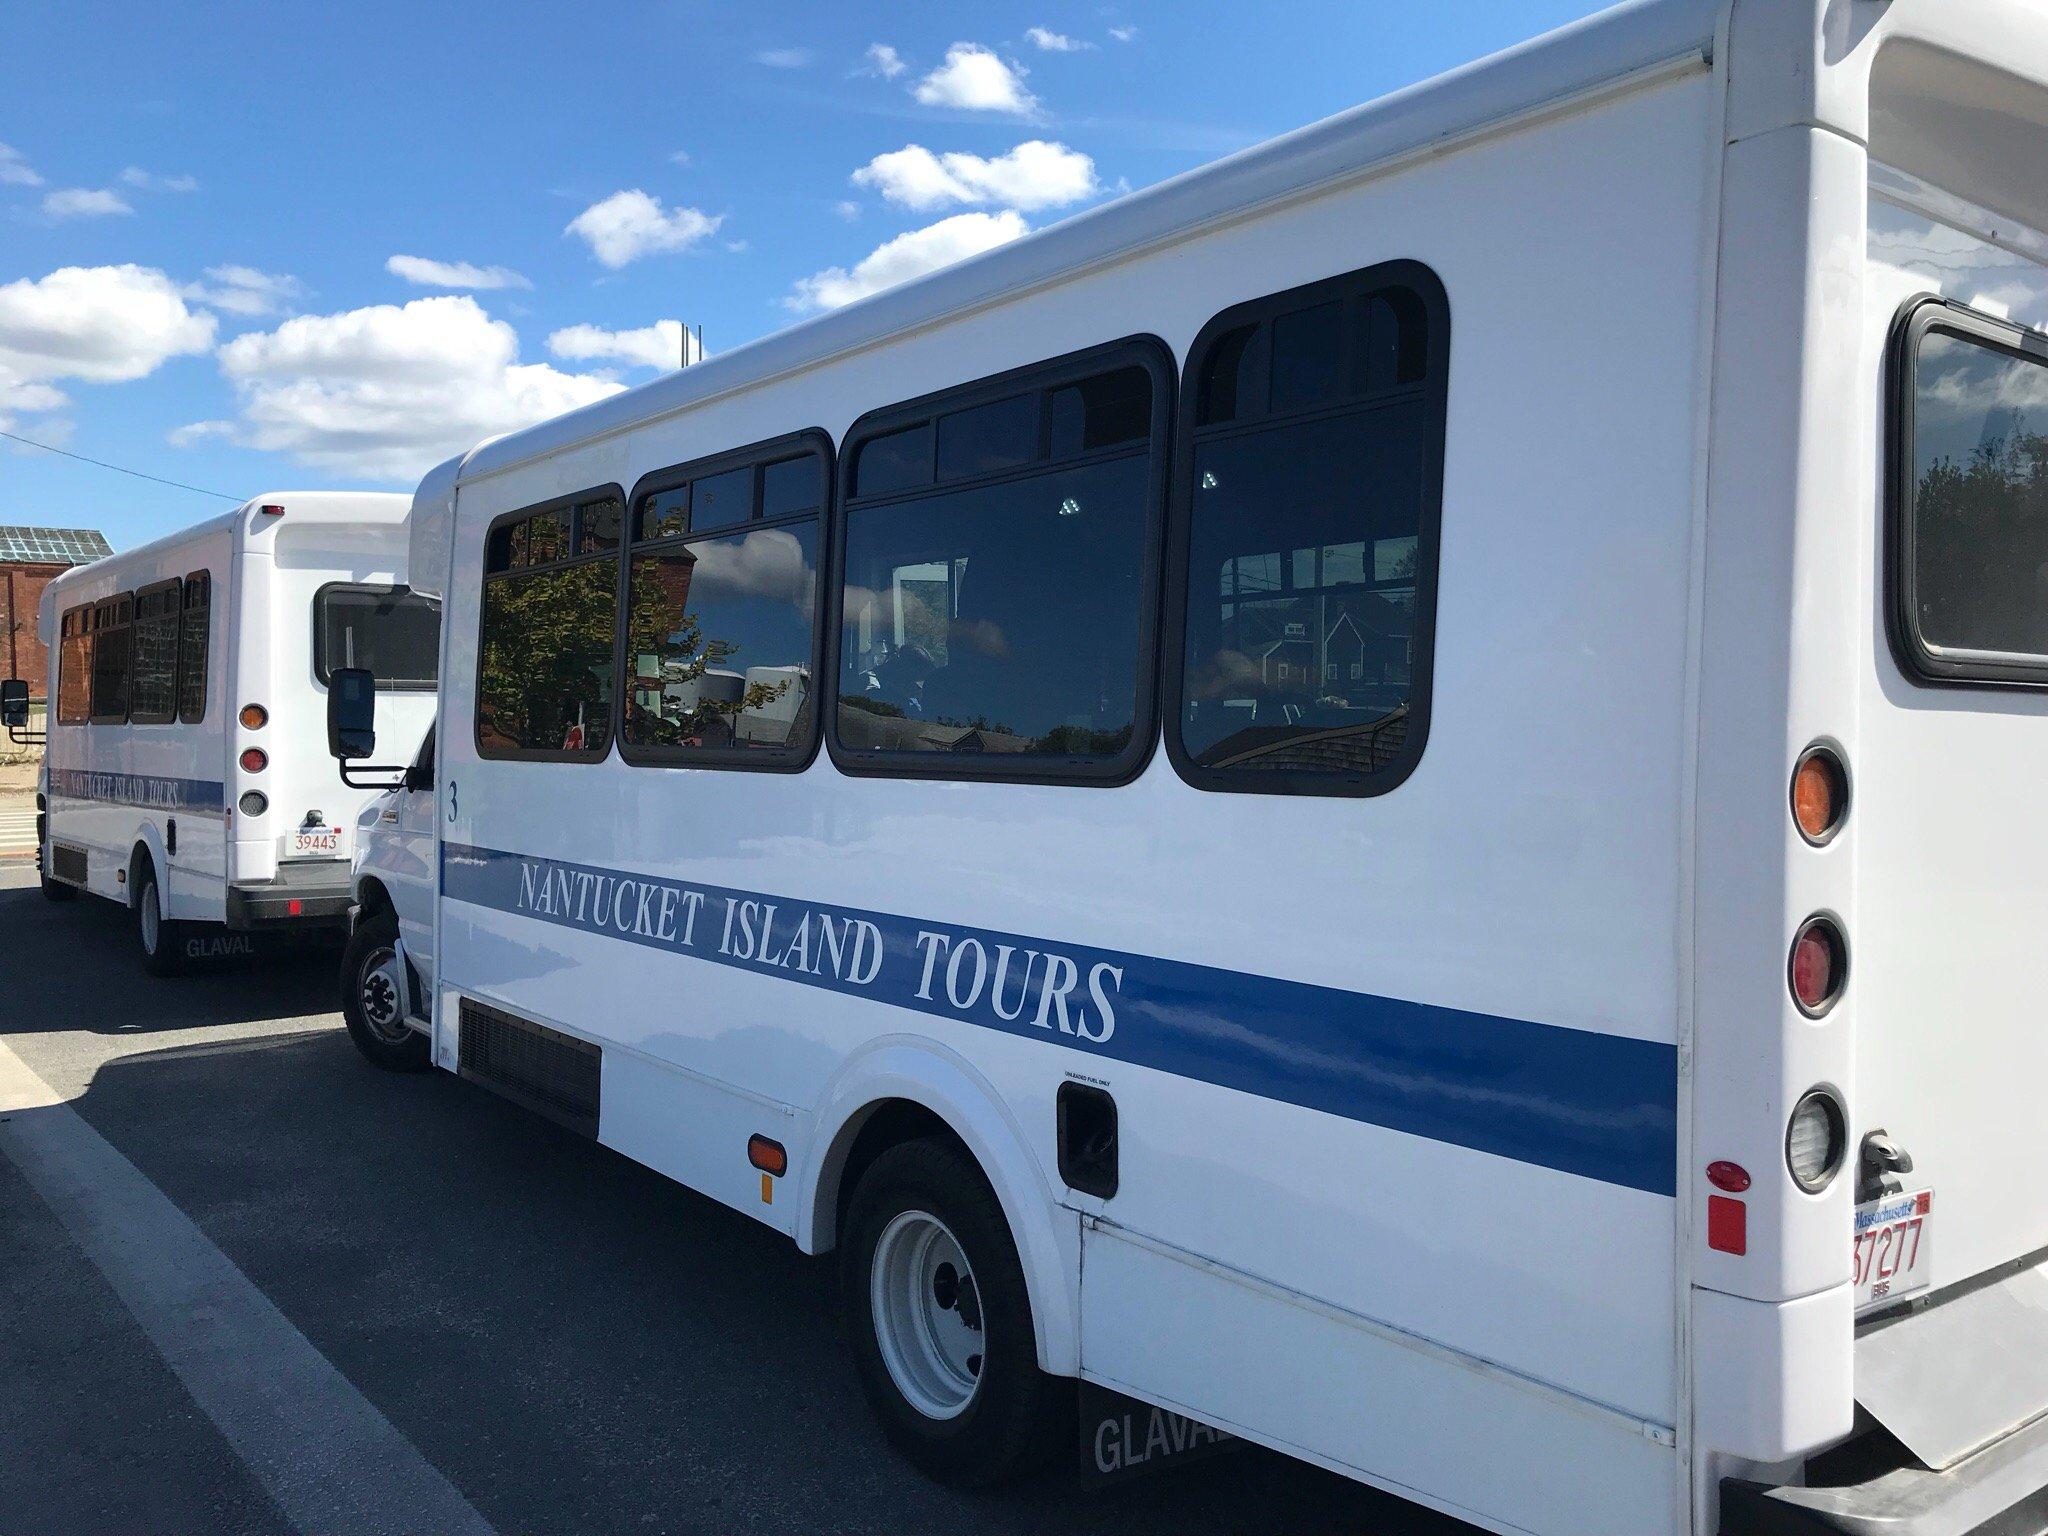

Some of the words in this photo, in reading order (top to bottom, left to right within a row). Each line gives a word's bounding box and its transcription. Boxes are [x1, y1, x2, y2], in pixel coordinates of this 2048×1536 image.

[115, 776, 144, 803] ISLAND
[149, 780, 178, 808] TOURS
[448, 780, 457, 822] 3
[295, 834, 337, 850] 39443
[186, 936, 254, 957] GLAVAL
[517, 862, 705, 946] NANTUCKET
[718, 897, 884, 985] ISLAND
[914, 930, 1123, 1043] TOURS
[1065, 1071, 1087, 1081] UNLEADED
[1872, 1280, 1890, 1297] BUS
